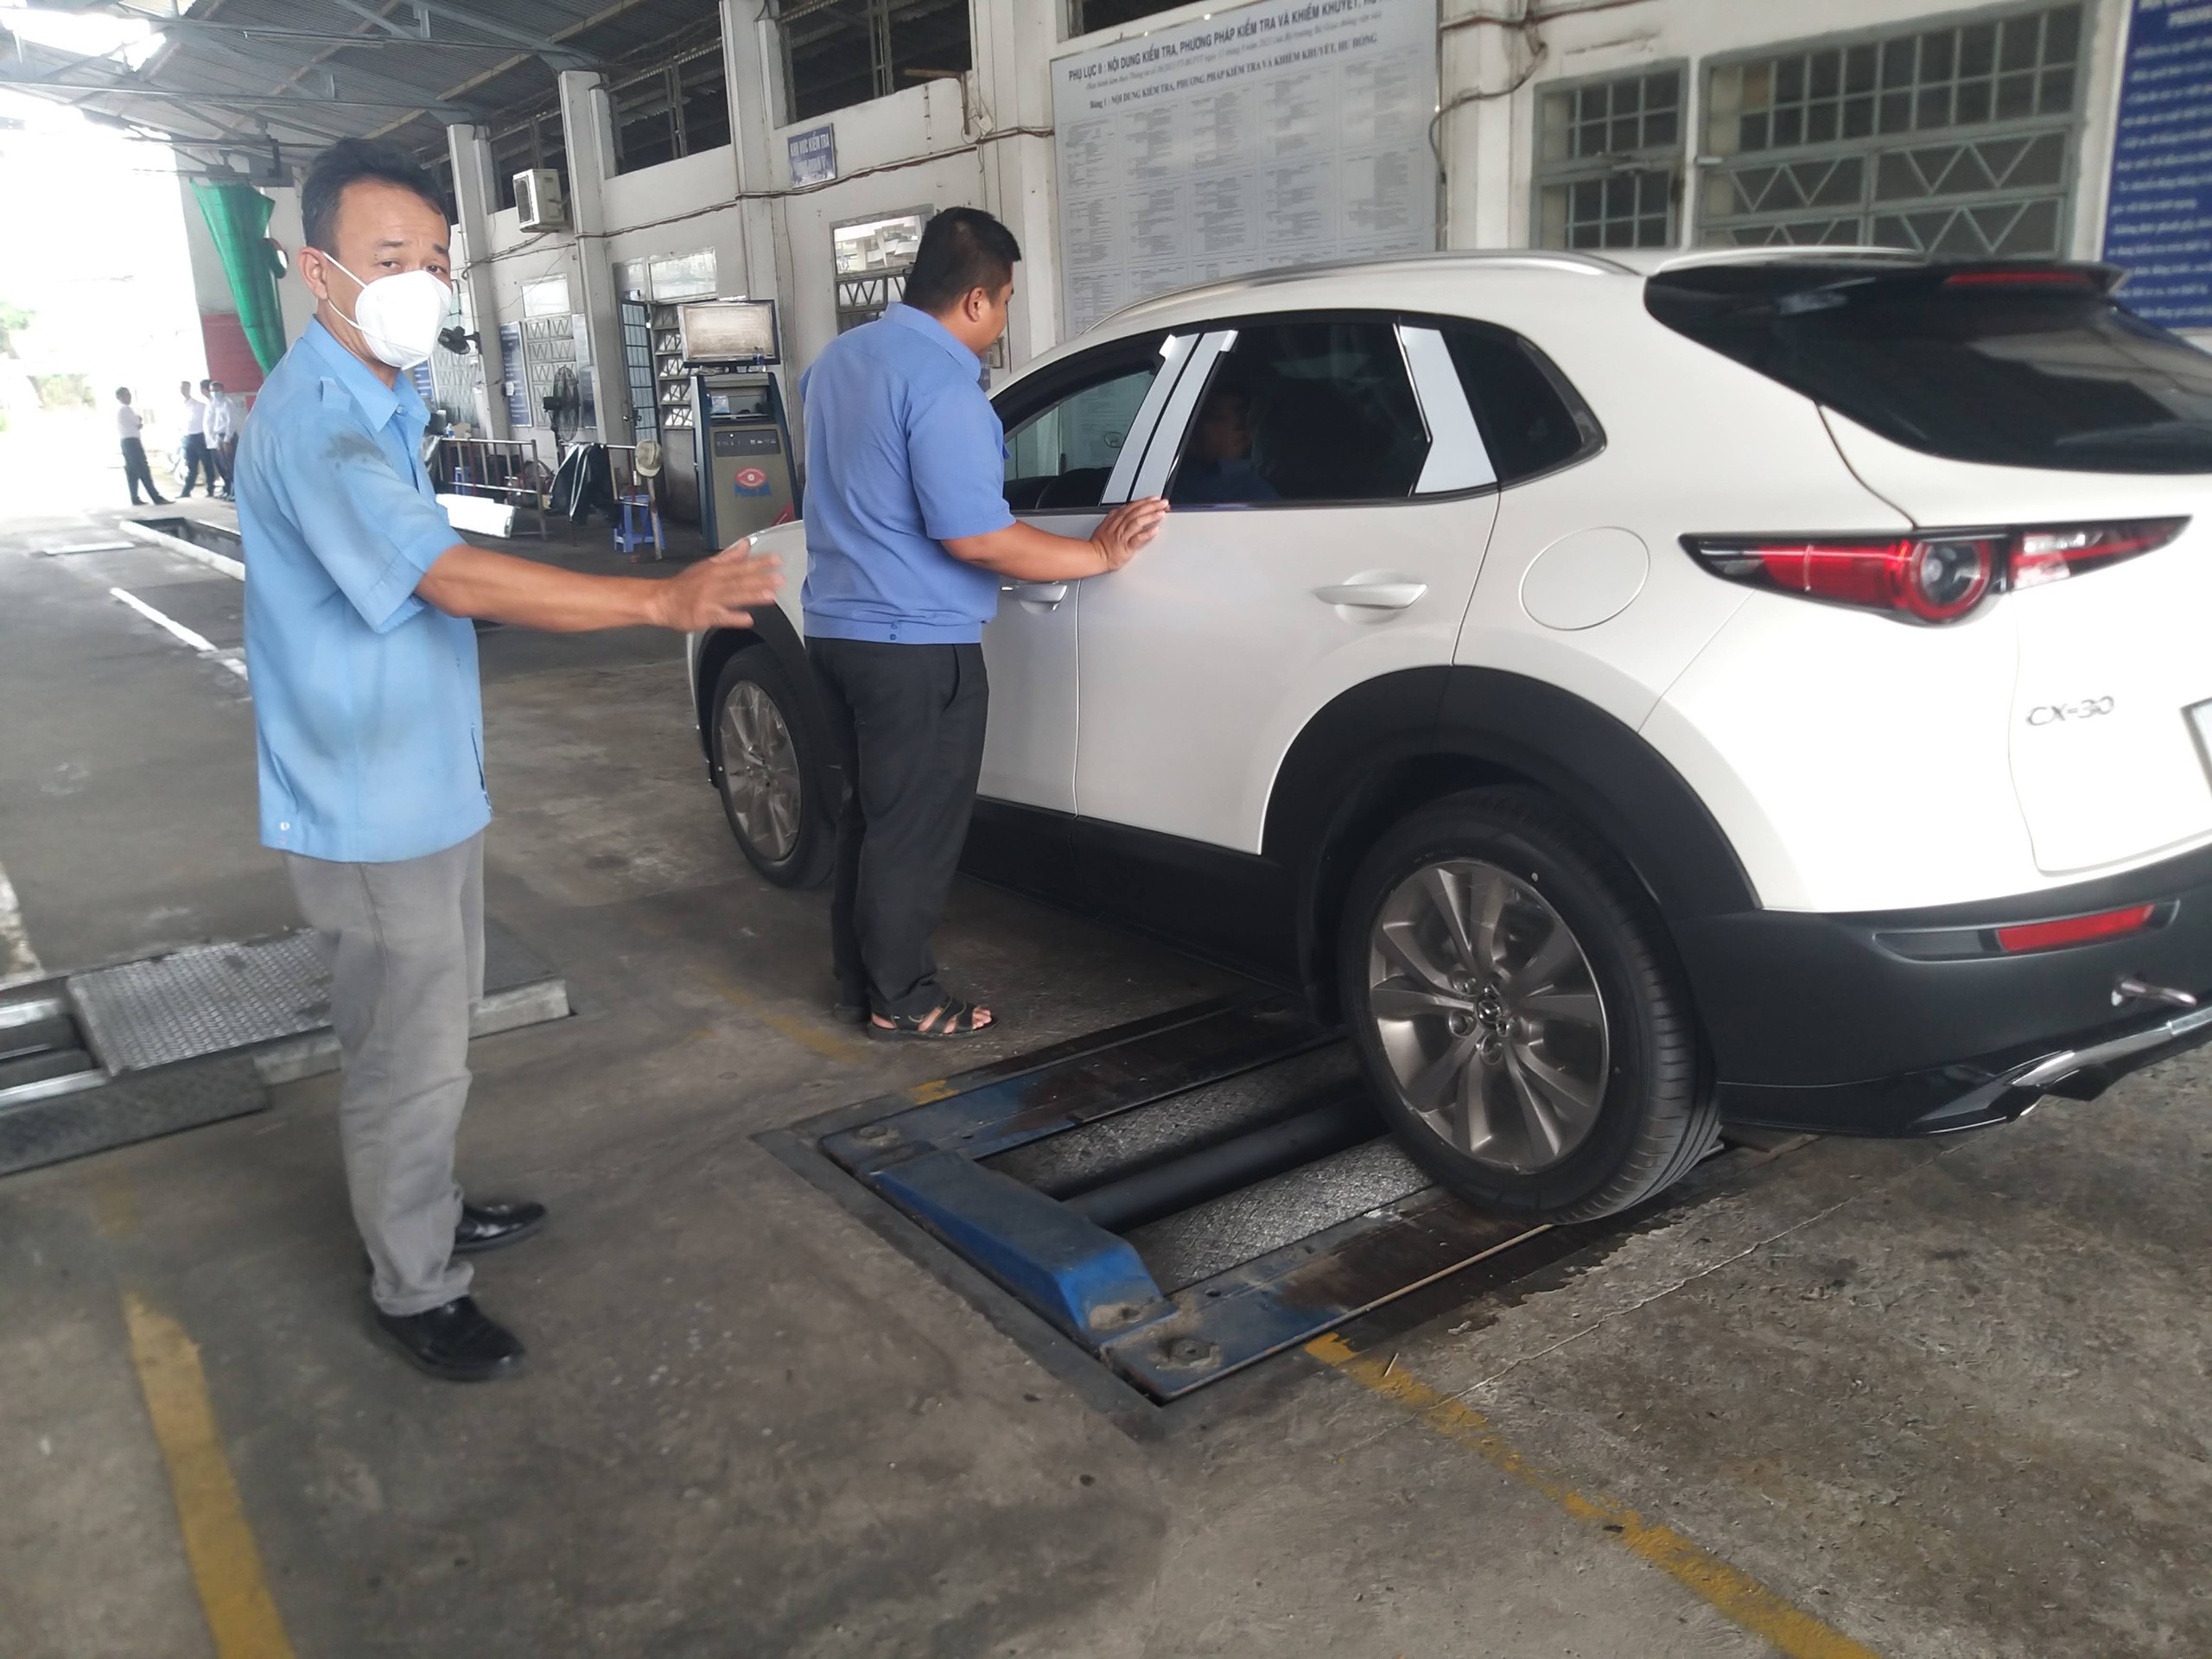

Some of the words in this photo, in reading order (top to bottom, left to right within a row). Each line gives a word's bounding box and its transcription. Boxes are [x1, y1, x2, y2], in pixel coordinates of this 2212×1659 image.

[1084, 63, 1096, 79] LỤC
[1107, 55, 1120, 73] NỘI
[1120, 53, 1141, 70] DUNG
[1259, 17, 1276, 32] TRA
[2025, 695, 2115, 727] CX-30
